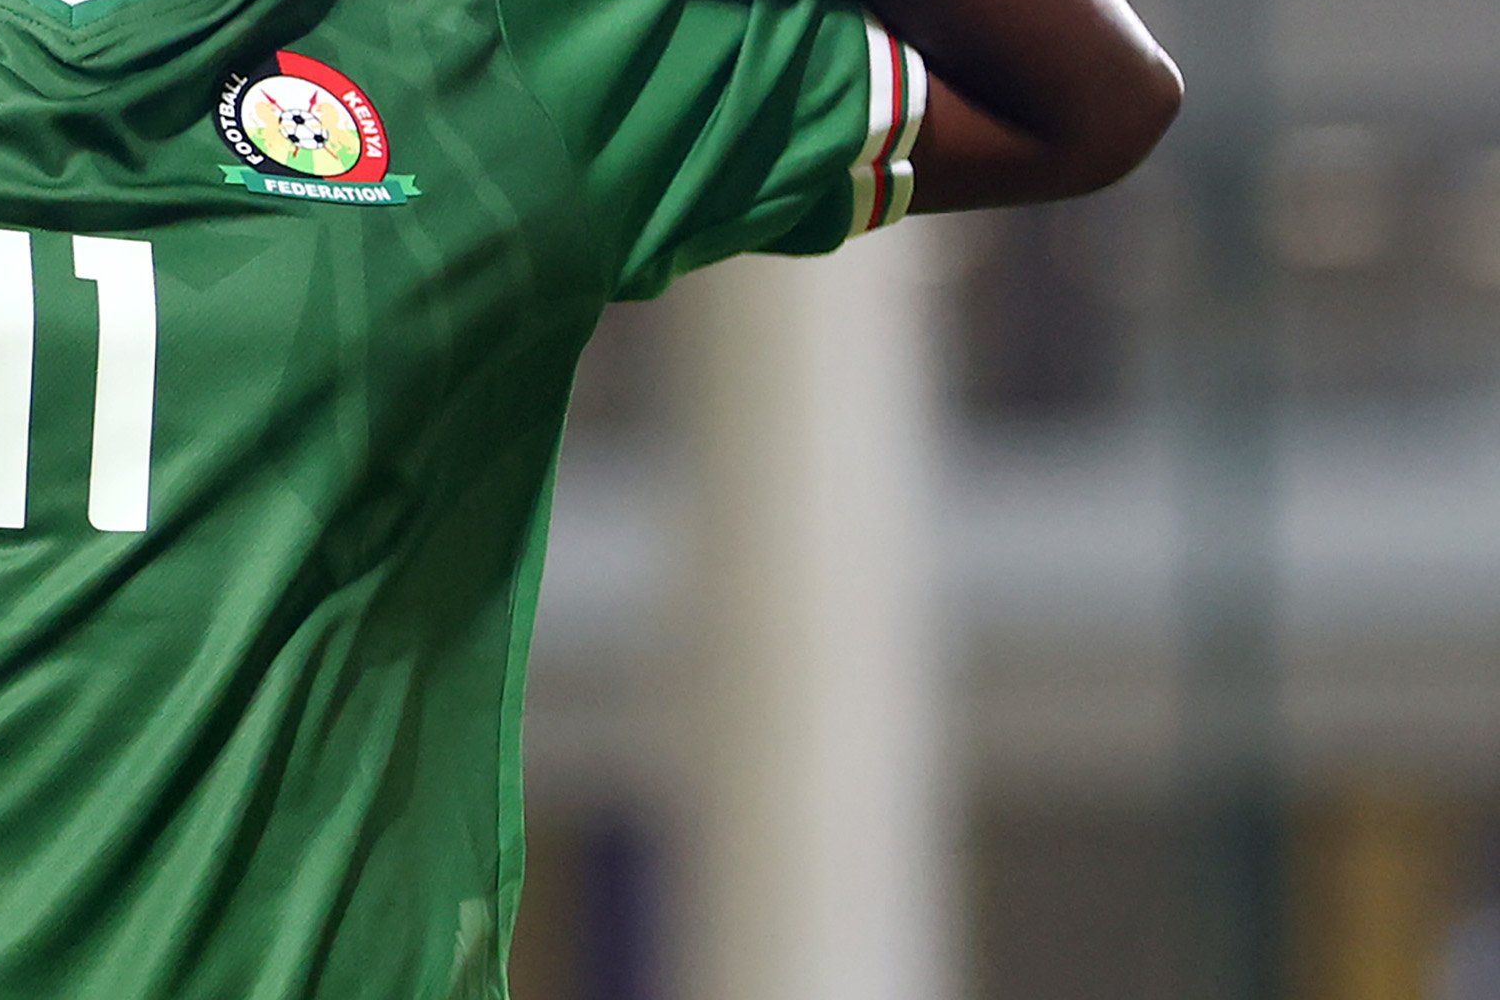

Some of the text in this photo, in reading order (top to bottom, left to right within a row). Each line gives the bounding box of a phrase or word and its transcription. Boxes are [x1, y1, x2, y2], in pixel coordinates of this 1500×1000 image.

[219, 73, 264, 165] FOOTBALL
[343, 90, 383, 158] KENYA
[264, 178, 391, 202] FEDERATION
